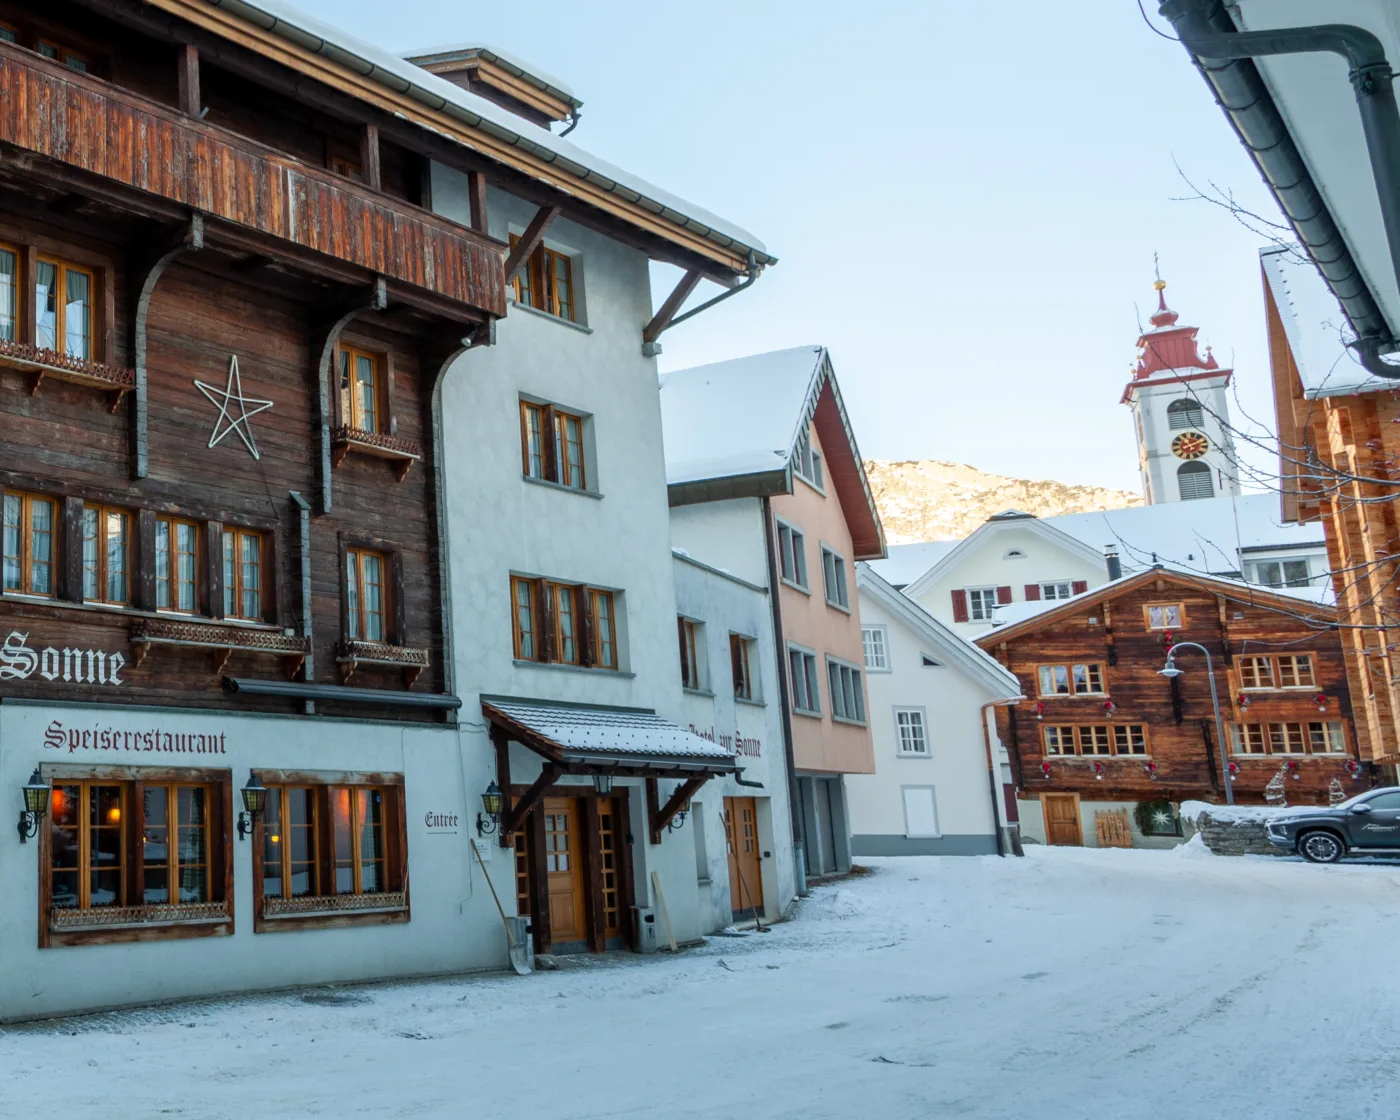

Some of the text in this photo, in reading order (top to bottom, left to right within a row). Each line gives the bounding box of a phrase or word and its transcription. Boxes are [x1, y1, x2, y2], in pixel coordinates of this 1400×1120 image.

[43, 720, 227, 754] Speiserestaurant
[735, 729, 761, 758] Sonne
[425, 811, 458, 828] Entrée
